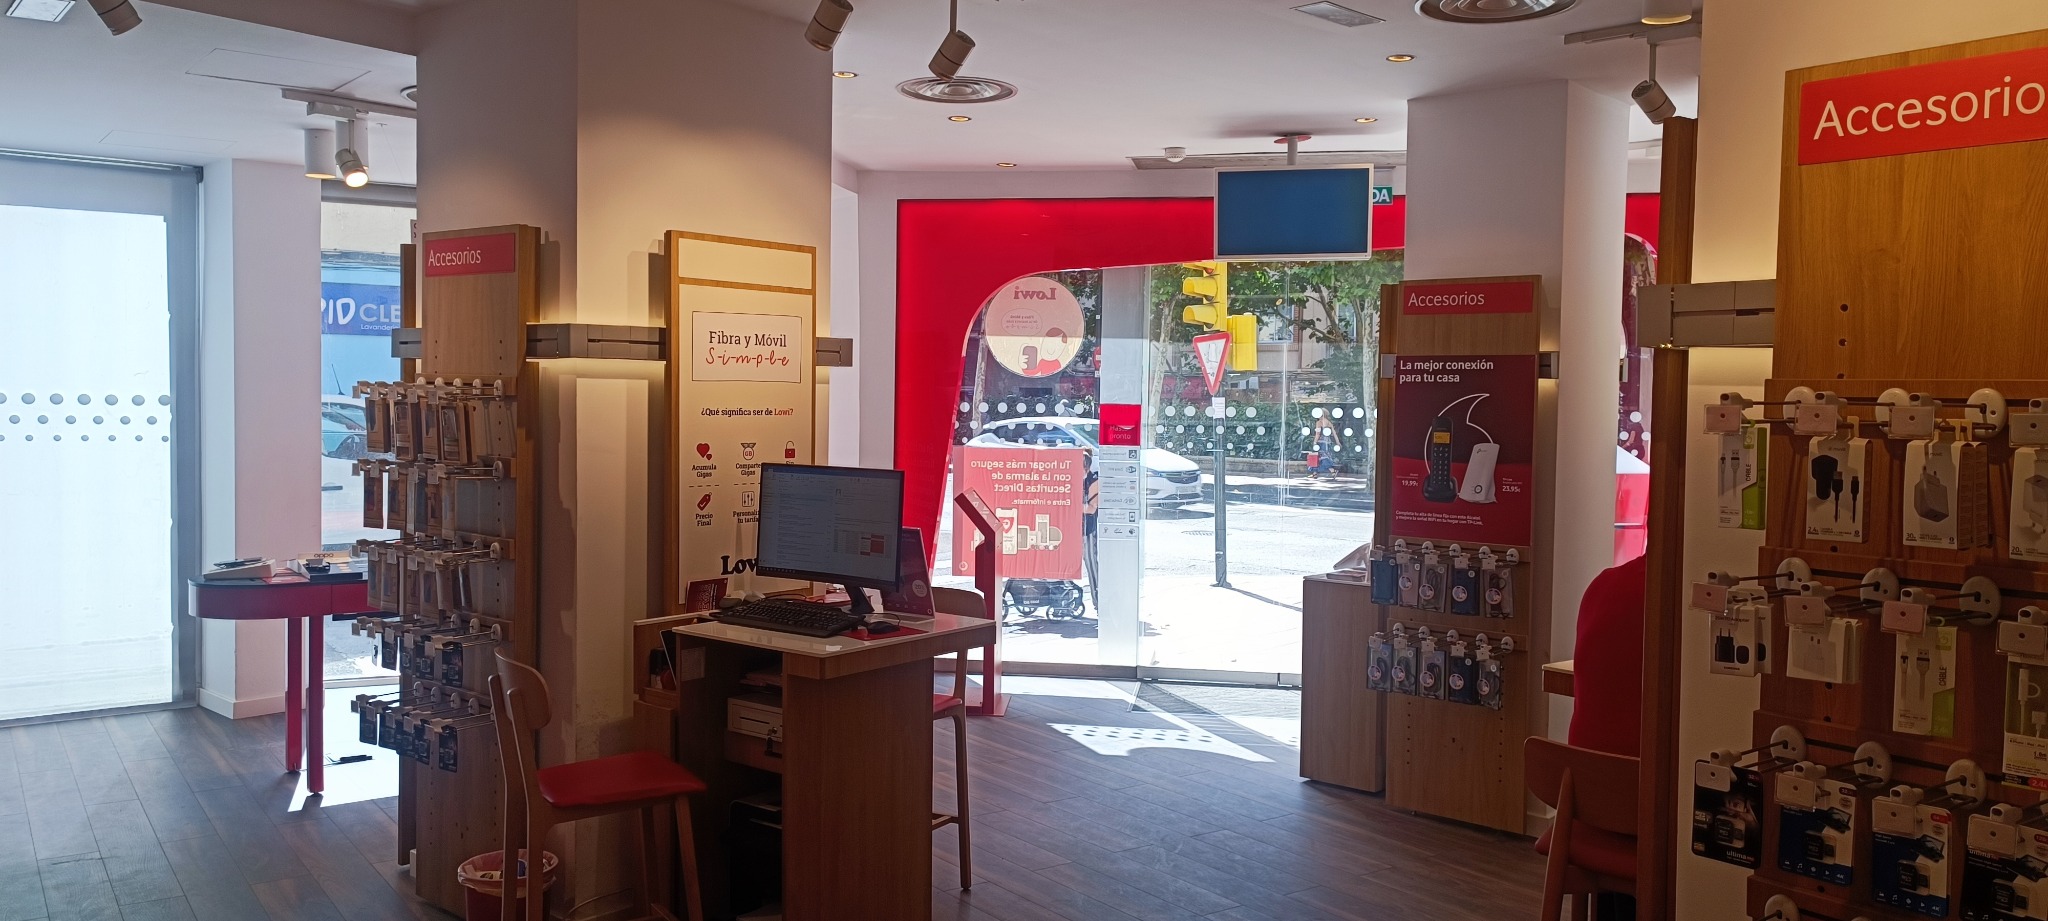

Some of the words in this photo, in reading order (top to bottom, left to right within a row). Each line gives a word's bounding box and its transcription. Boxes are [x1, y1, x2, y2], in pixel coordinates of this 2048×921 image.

[428, 246, 482, 267] Accesorios
[1408, 291, 1485, 307] Accesorios
[708, 330, 741, 345] Fibra
[744, 335, 751, 348] y
[754, 333, 787, 348] Móvil
[1400, 360, 1412, 370] La
[1414, 360, 1444, 372] mejor
[1446, 359, 1494, 370] conexión
[1399, 374, 1422, 384] para
[1423, 374, 1435, 382] tu
[1436, 374, 1460, 383] casa
[700, 407, 720, 416] ¿Qué
[721, 407, 752, 417] significa
[752, 408, 764, 416] ser
[764, 407, 773, 416] de
[774, 407, 794, 416] Lowi?
[691, 463, 717, 471] Acumula
[735, 462, 760, 470] Comparte
[740, 469, 756, 477] Gigas
[697, 519, 712, 527] Final
[1938, 666, 1948, 687] CABLE
